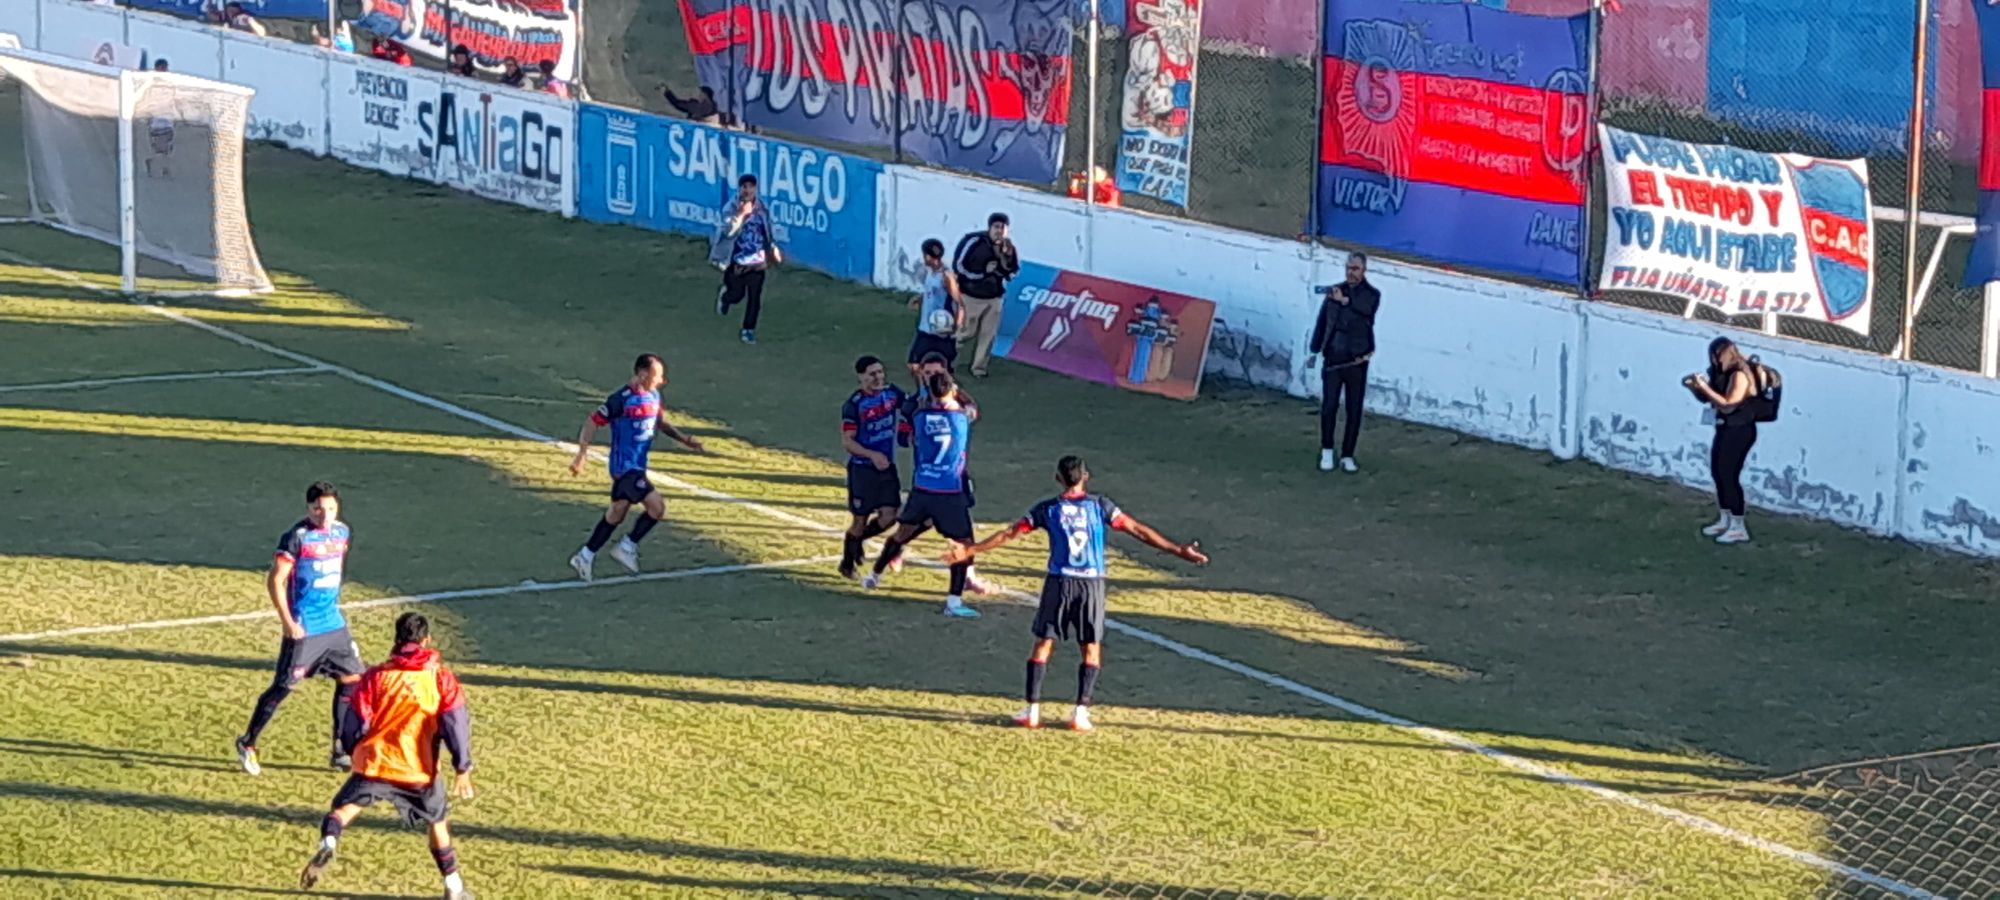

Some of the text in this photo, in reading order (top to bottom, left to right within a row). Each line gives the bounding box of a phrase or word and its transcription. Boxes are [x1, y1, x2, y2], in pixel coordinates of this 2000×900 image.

[827, 0, 989, 148] PIRATAS
[669, 123, 847, 213] SANTIAGO
[770, 199, 828, 233] CIUDAD
[1627, 169, 1783, 227] EL TIEMPO Y
[1612, 207, 1656, 251] YO
[1018, 285, 1121, 331] sporting
[1738, 289, 1768, 312] LA
[933, 434, 952, 465] 7
